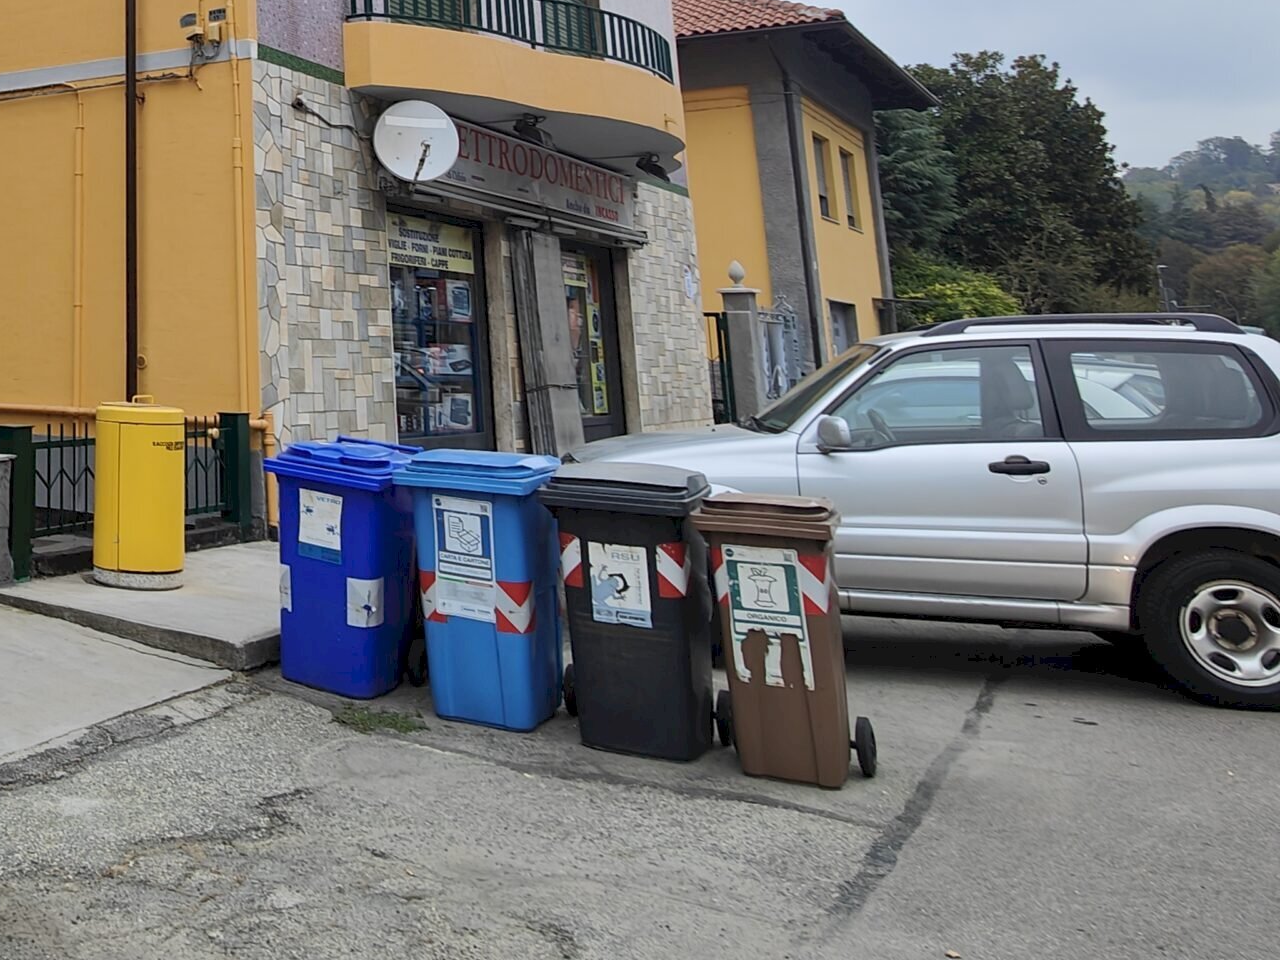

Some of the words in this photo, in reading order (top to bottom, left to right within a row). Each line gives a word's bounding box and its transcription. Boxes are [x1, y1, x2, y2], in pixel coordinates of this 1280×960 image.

[458, 125, 625, 205] ETTRODOMESTICI
[398, 227, 440, 243] SOSTITUZIONE
[411, 242, 428, 254] FORNI
[432, 246, 448, 257] PIANI
[448, 248, 472, 260] COTTURA
[391, 252, 427, 266] FRIGORIFERI
[431, 257, 449, 269] CAPPE
[316, 495, 341, 505] VETRO
[440, 552, 457, 561] CARTA
[463, 556, 490, 566] CARTONE
[611, 551, 640, 561] RSU
[746, 612, 787, 623] ORGANICO
